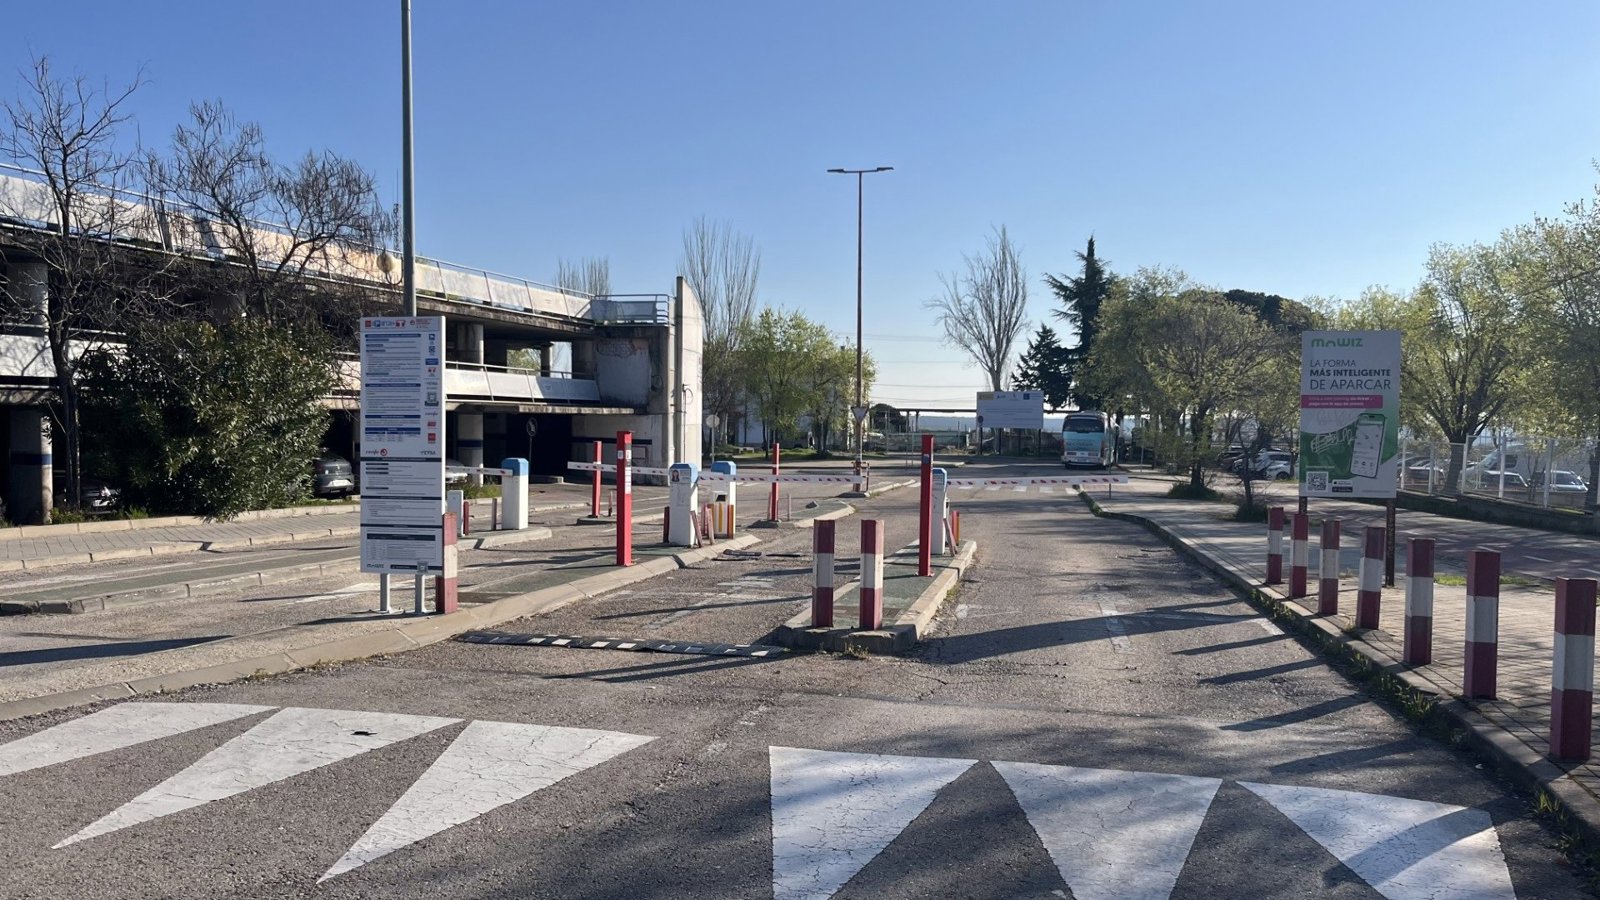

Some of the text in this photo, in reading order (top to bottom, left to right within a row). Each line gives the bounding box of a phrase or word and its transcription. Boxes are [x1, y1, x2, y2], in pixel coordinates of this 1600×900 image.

[1310, 368, 1331, 376] MÁS
[1310, 379, 1391, 390] DE APARCAR
